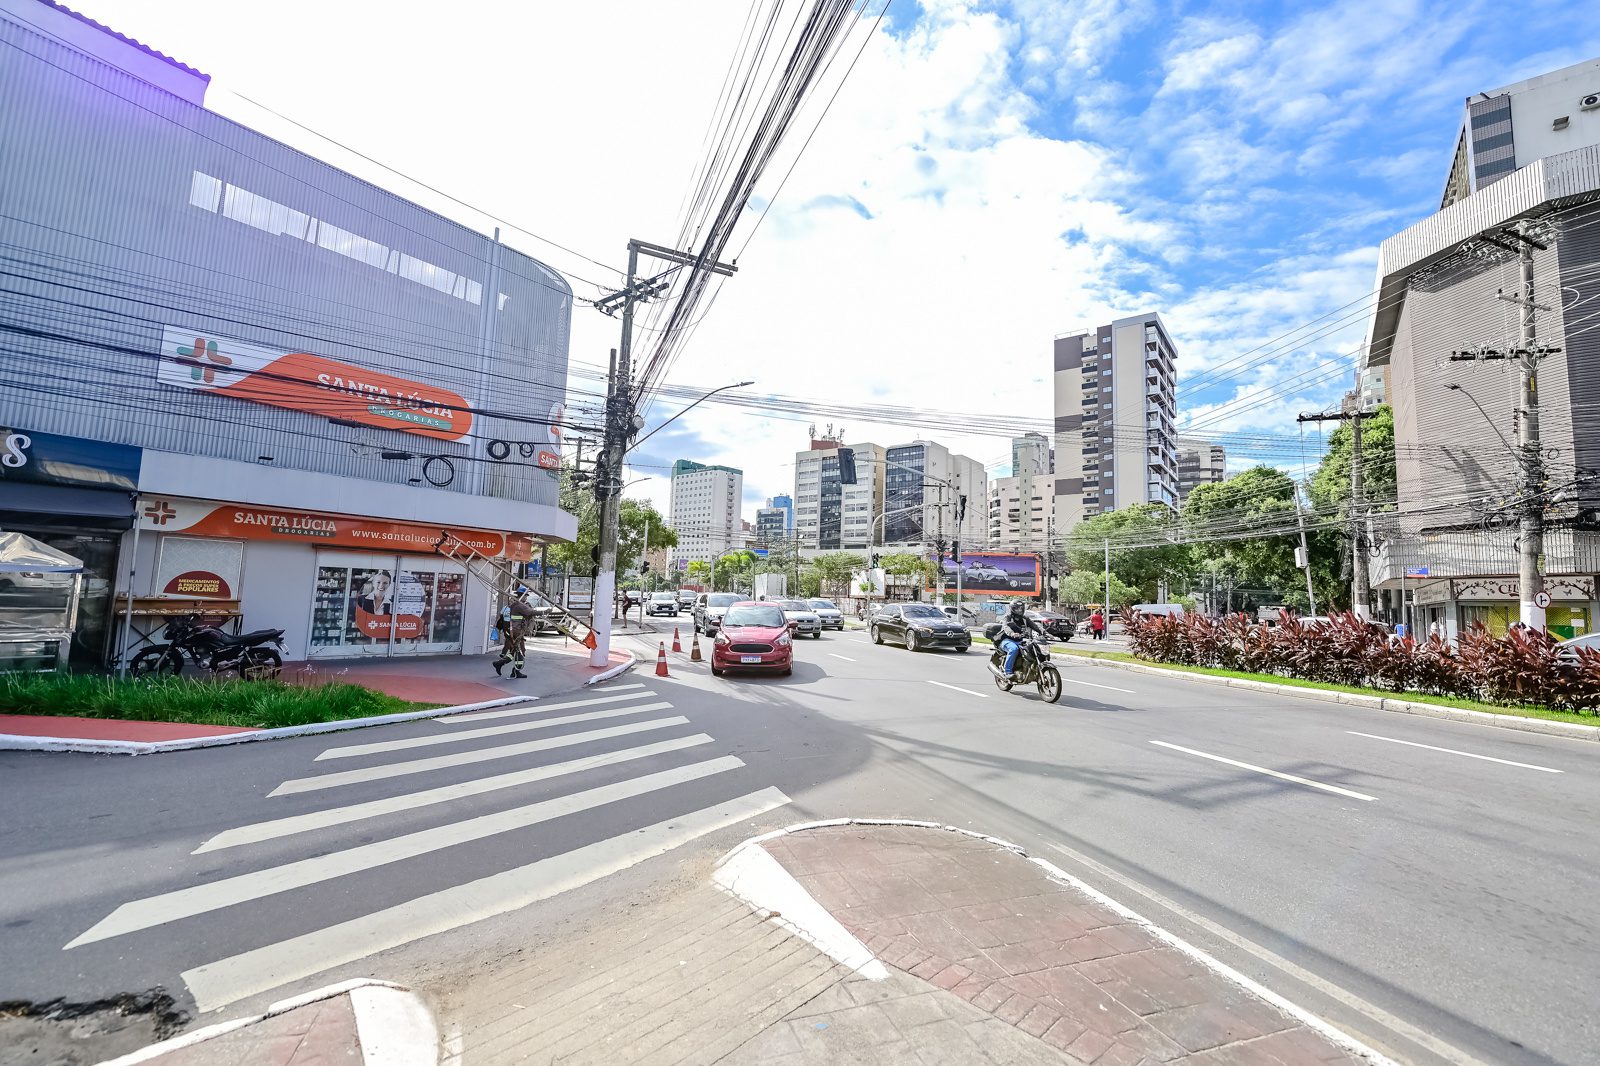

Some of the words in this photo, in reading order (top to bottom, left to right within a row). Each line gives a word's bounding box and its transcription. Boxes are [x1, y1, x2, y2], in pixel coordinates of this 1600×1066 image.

[317, 373, 390, 404] SANTA
[372, 405, 439, 426] DROGARIAS
[1, 433, 32, 468] S
[234, 511, 290, 528] SANTA
[292, 515, 337, 532] LÚCIA
[278, 528, 330, 537] DROGARIAS
